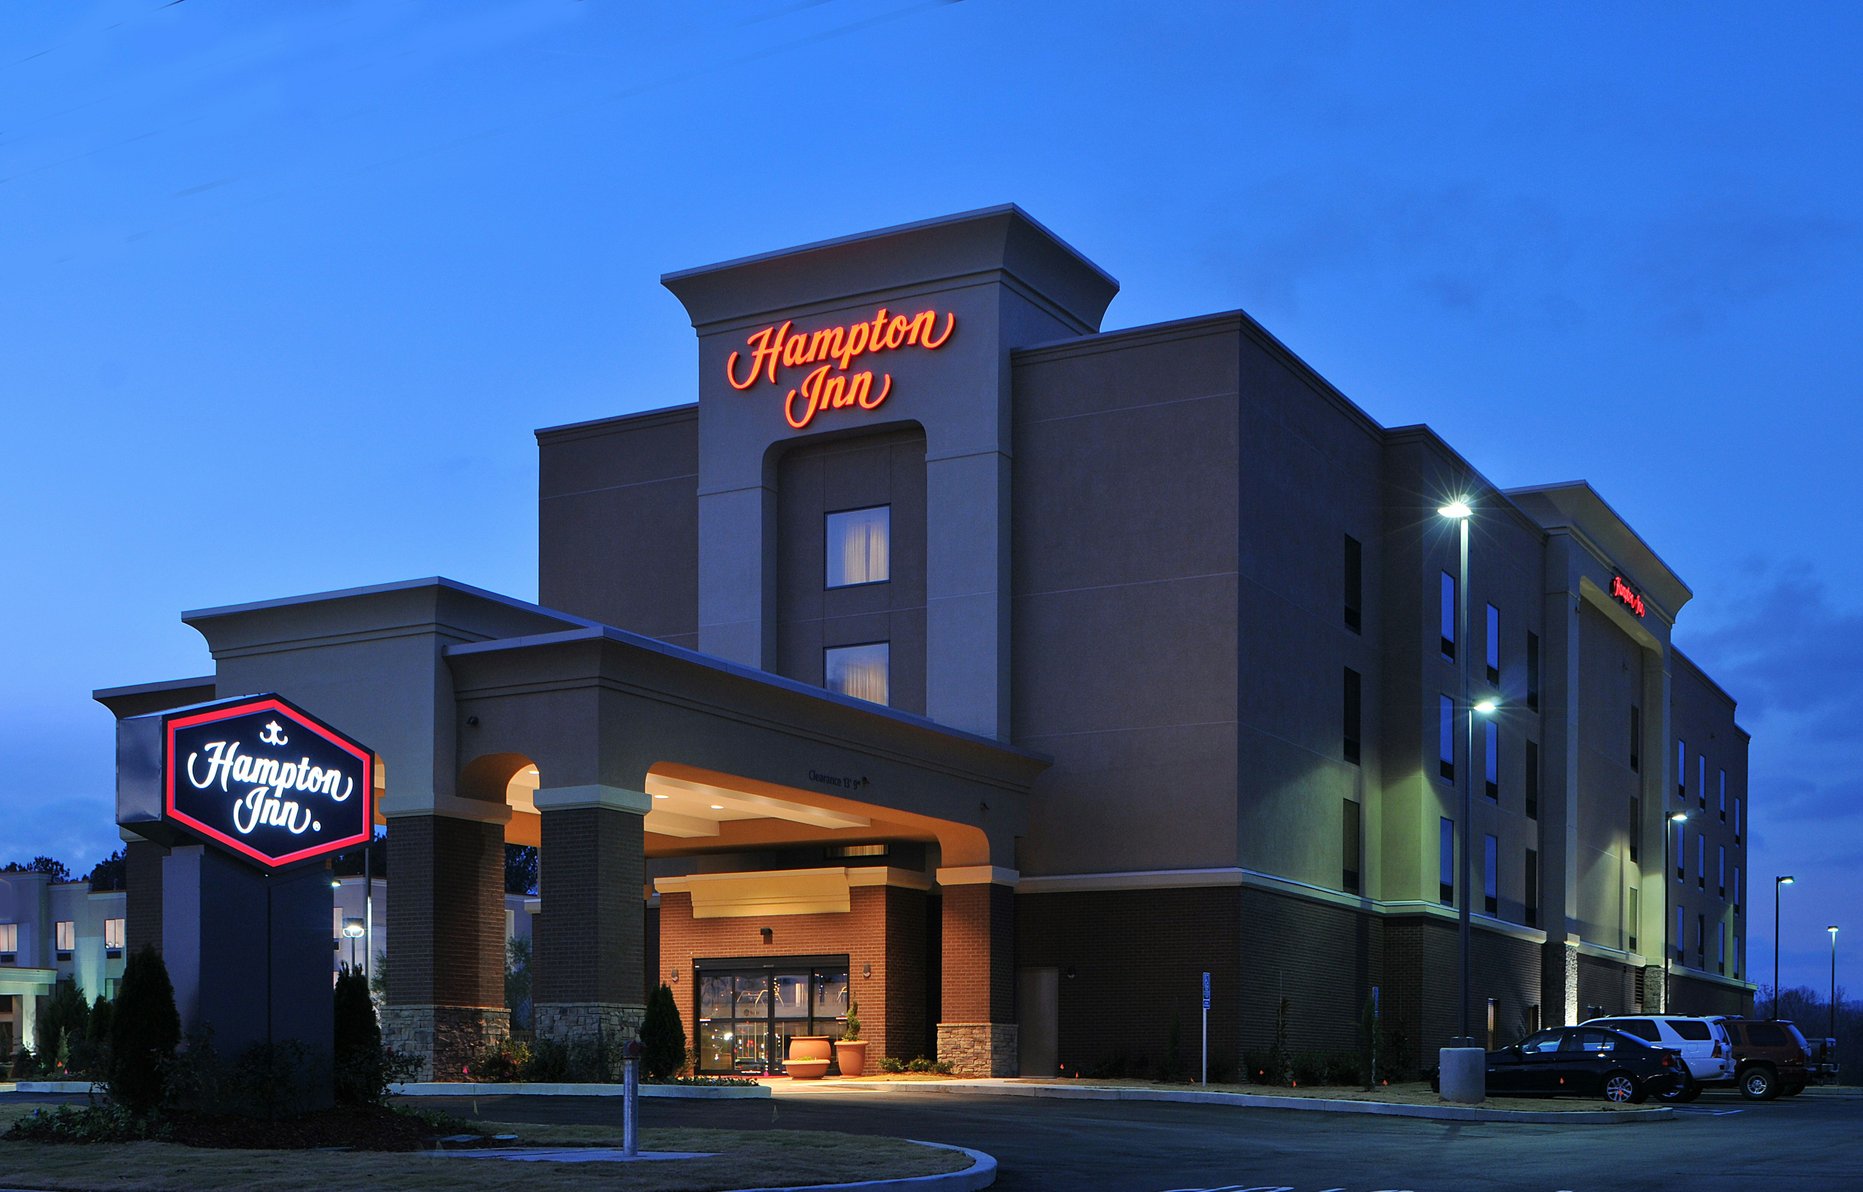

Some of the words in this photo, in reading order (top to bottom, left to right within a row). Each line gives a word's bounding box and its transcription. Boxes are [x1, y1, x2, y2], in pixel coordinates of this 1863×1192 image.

[727, 308, 956, 390] Hampton
[784, 364, 893, 429] Inn
[187, 741, 354, 802] Hampton
[808, 769, 842, 787] Clearance
